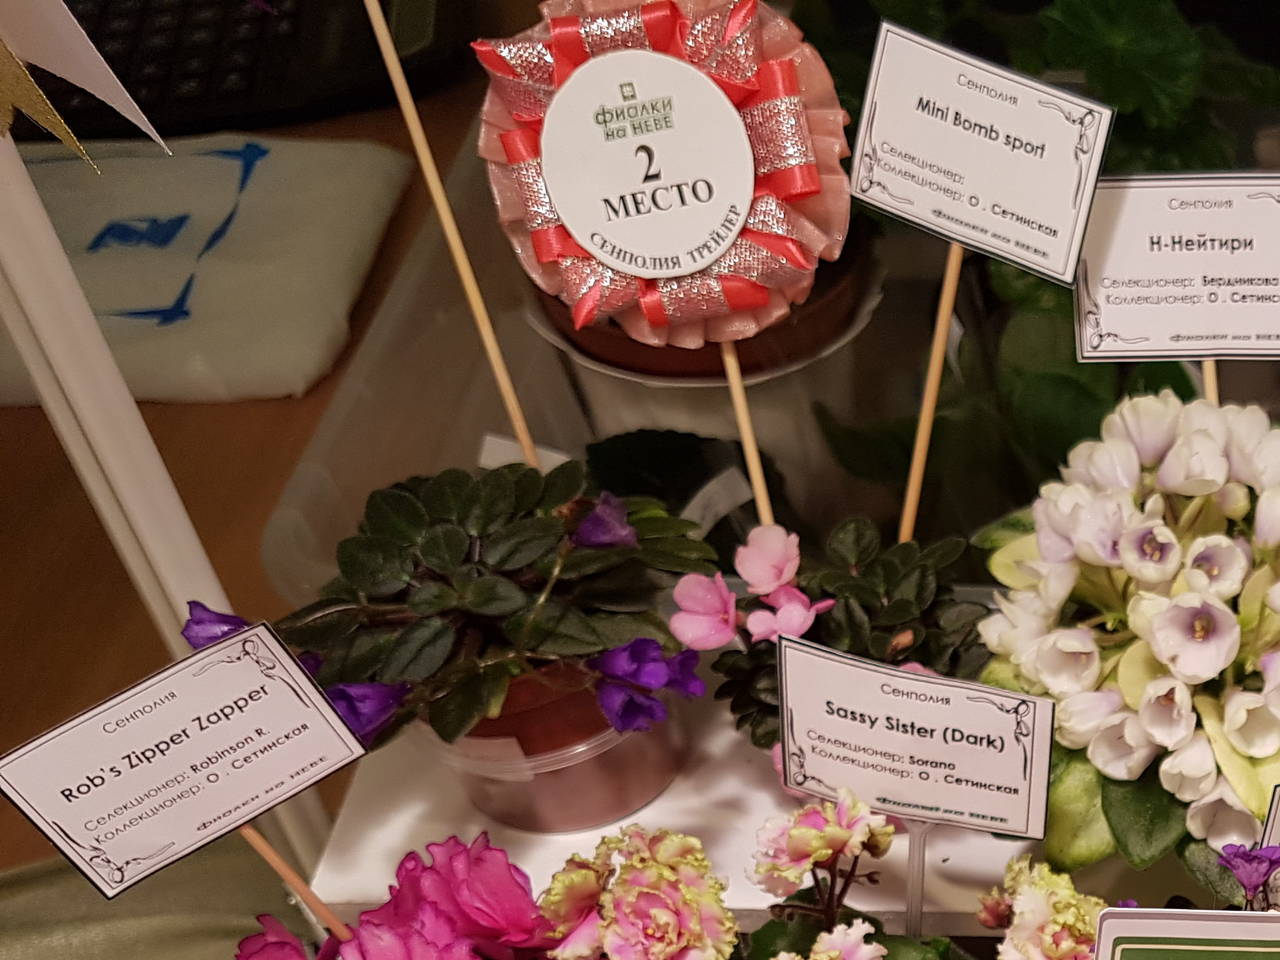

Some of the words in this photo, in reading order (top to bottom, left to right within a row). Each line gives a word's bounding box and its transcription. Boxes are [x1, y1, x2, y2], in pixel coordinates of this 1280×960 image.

[957, 73, 1019, 106] Сенполия
[633, 116, 672, 135] НЕВЕ
[915, 97, 950, 122] Mini
[953, 112, 999, 141] Bomb
[1004, 133, 1046, 160] sport
[635, 145, 661, 184] 2
[603, 179, 714, 222] МЕСТО
[1168, 198, 1234, 210] Сенполия
[590, 232, 681, 270] СЕНПОЛИЯ
[687, 205, 742, 264] ТРЕЙЛЕР
[991, 204, 1058, 238] Сетинская
[1150, 234, 1254, 254] Н-Нейтири
[102, 691, 178, 734] Сенполия
[881, 683, 951, 705] Сенполия
[60, 768, 121, 803] Rob's
[121, 726, 192, 770] Zipper
[192, 684, 271, 731] Zapper
[826, 701, 878, 729] Sassy
[885, 717, 937, 739] Sister
[943, 727, 1005, 753] (Dark)
[807, 730, 904, 763] Селекционер:
[909, 755, 956, 770] Sorano
[84, 772, 190, 832] Селекционер:
[190, 736, 256, 774] Robinson
[256, 726, 271, 738] R.
[94, 783, 205, 845] Коллекционер:
[231, 723, 310, 770] Сетинская
[944, 775, 1019, 795] Сетинская
